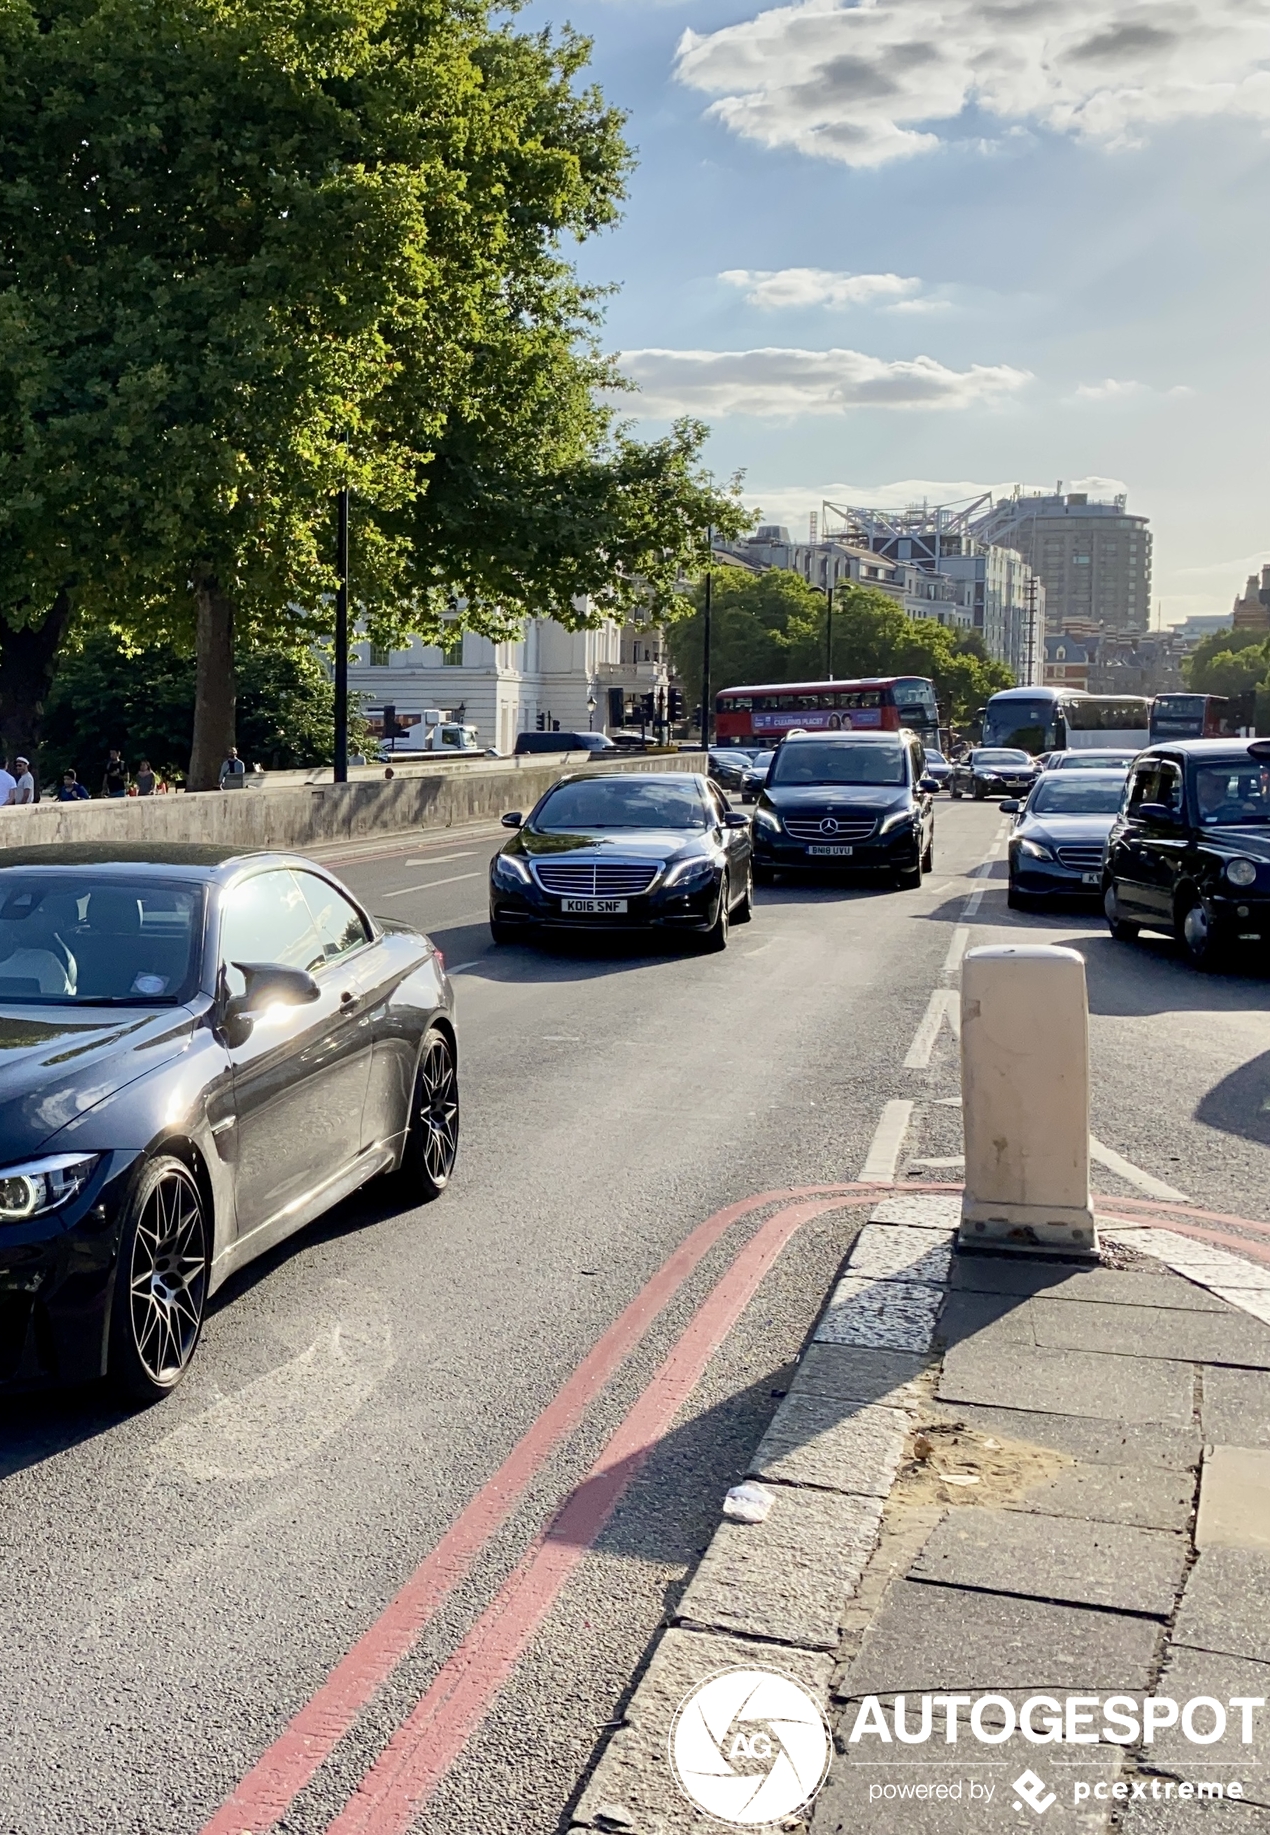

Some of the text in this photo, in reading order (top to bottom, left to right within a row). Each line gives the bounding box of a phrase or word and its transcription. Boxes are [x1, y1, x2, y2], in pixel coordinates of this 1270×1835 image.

[833, 846, 850, 855] UVU
[567, 900, 621, 912] KO16 SNF
